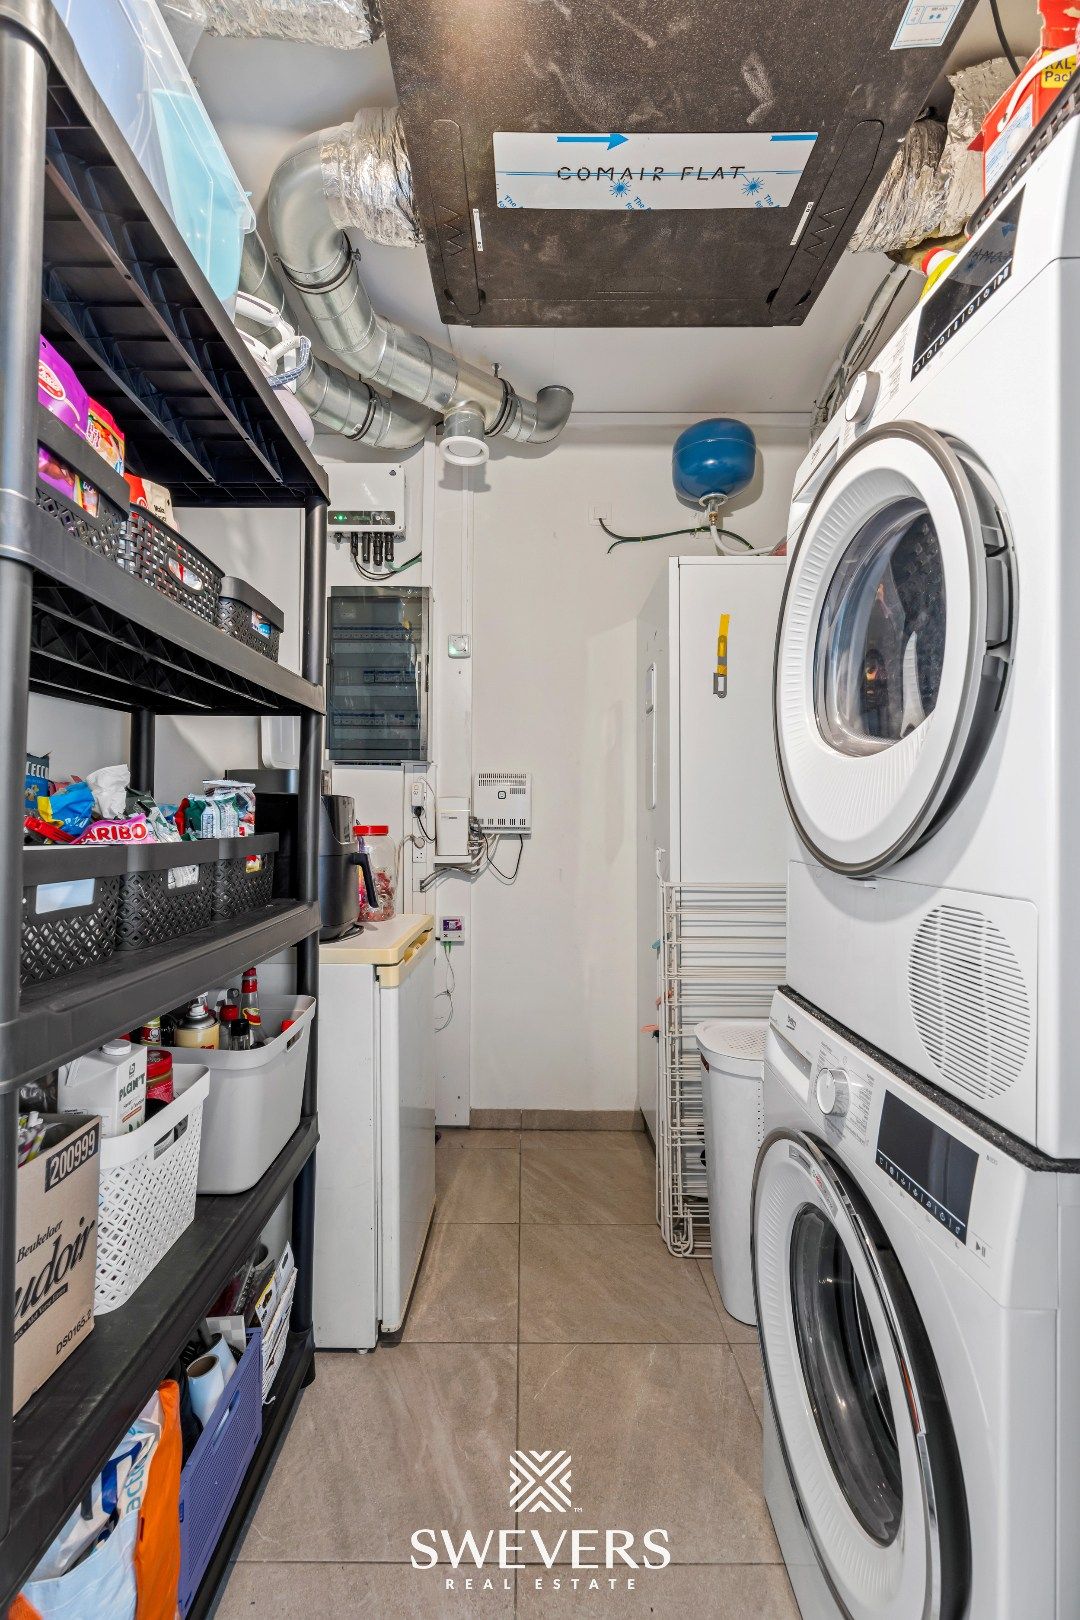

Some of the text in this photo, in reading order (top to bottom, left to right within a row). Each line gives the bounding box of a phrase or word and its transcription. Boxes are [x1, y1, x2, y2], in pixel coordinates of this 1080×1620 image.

[557, 166, 746, 181] COMAIR FLAT
[504, 195, 517, 208] The
[633, 196, 645, 209] The
[763, 194, 774, 206] The
[81, 822, 148, 842] ARIBO
[50, 1129, 96, 1187] 200999
[14, 1216, 95, 1319] udoir
